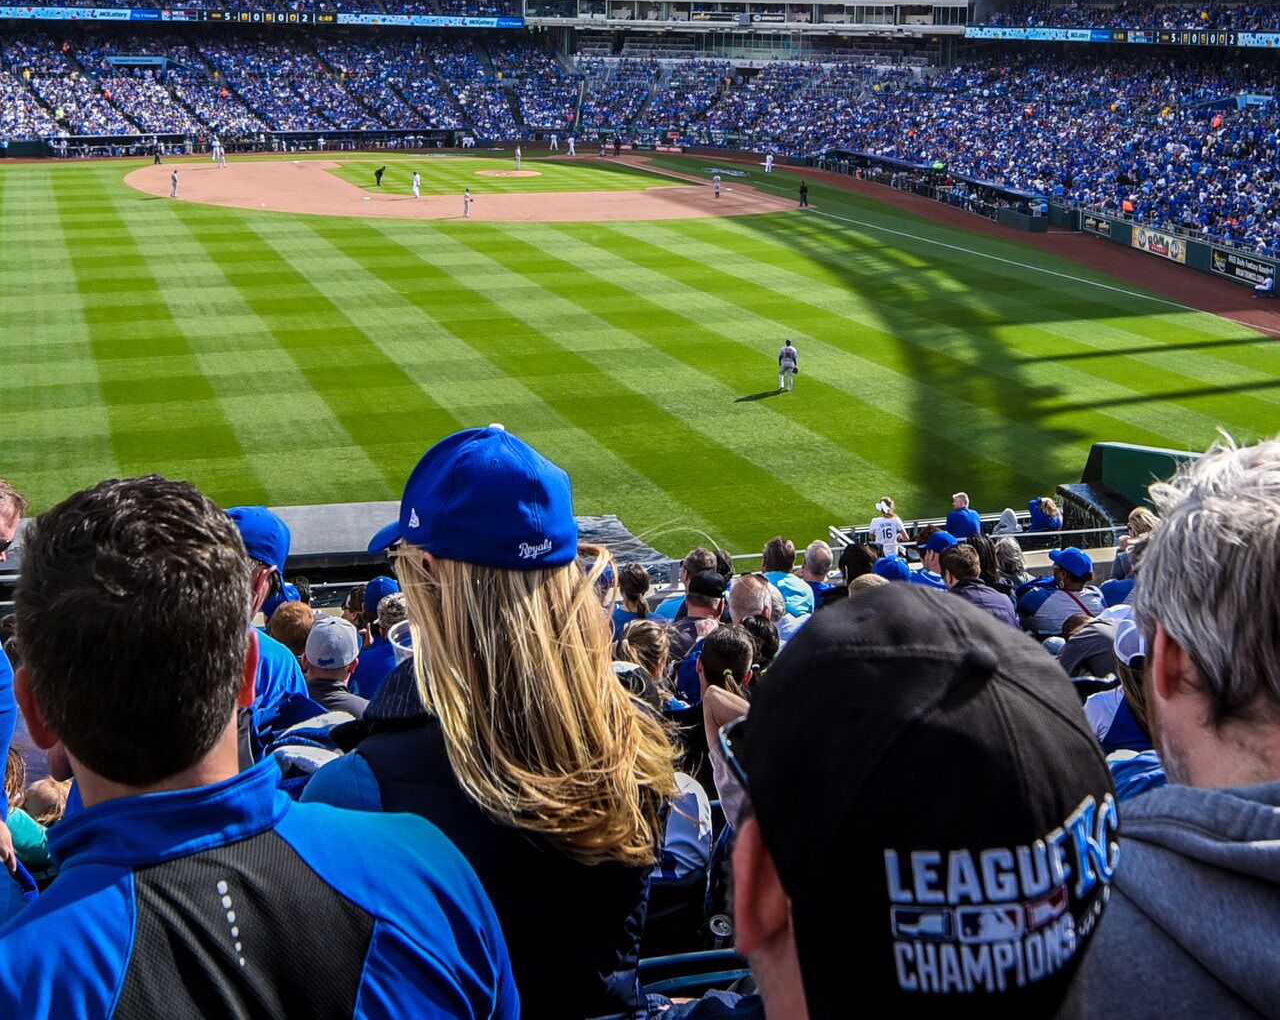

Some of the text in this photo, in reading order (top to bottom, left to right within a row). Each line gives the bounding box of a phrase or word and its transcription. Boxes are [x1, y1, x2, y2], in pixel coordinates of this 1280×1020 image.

[225, 12, 230, 21] 5
[241, 12, 248, 21] B
[253, 12, 260, 21] 0
[265, 13, 272, 21] S
[277, 13, 284, 22] 0
[302, 13, 308, 22] 2
[1171, 31, 1176, 42] 5
[1192, 31, 1197, 42] 0
[1210, 32, 1216, 43] 0
[1229, 33, 1235, 44] 2
[1147, 233, 1169, 248] ROMA
[882, 527, 893, 540] 16
[519, 538, 552, 560] Royals
[1064, 792, 1120, 898] KC
[883, 826, 1071, 905] LEAGUE
[893, 912, 1077, 994] CHAMPIONS
